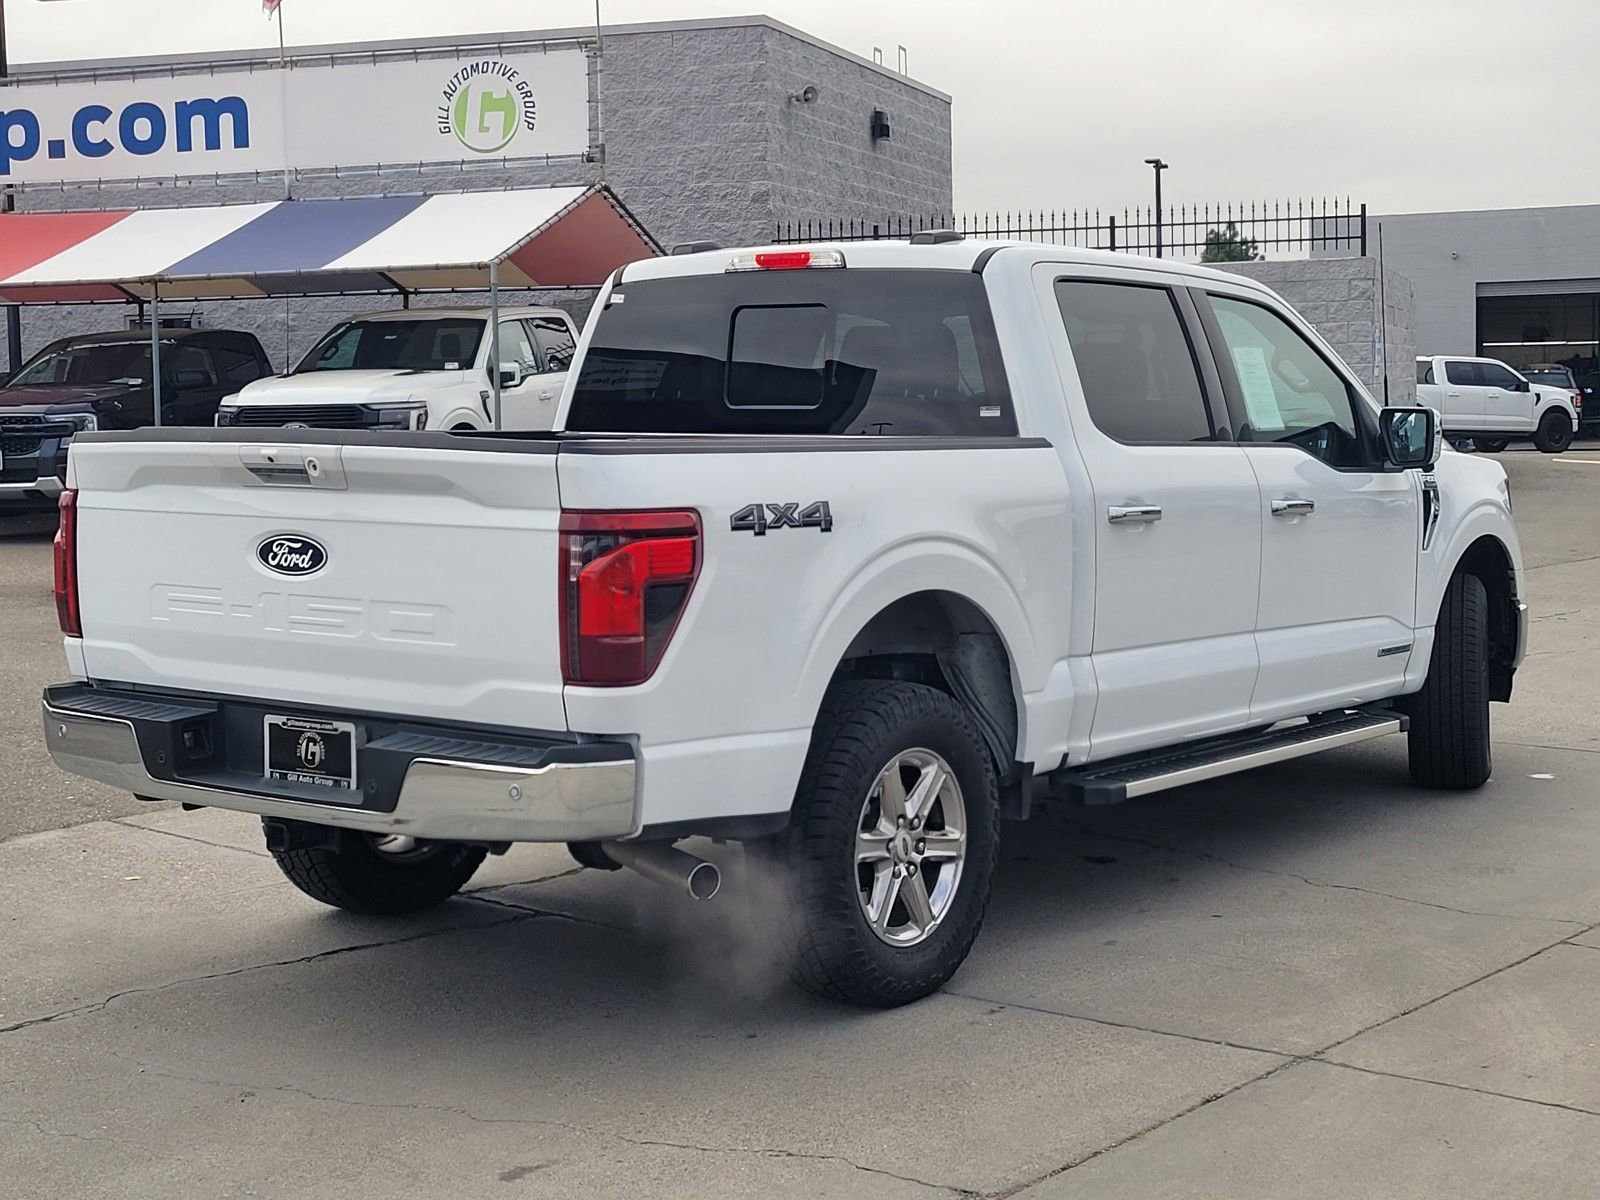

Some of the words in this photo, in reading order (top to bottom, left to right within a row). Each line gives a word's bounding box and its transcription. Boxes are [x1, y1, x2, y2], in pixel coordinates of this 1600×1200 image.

[443, 61, 519, 102] AUTOMOTIVE
[438, 105, 451, 134] GILL
[515, 81, 536, 131] GROUP
[0, 96, 250, 176] p.com
[268, 540, 313, 568] Ford
[150, 583, 456, 646] F-150
[287, 773, 298, 781] Gill
[299, 774, 313, 783] Auto
[314, 776, 333, 787] Group
